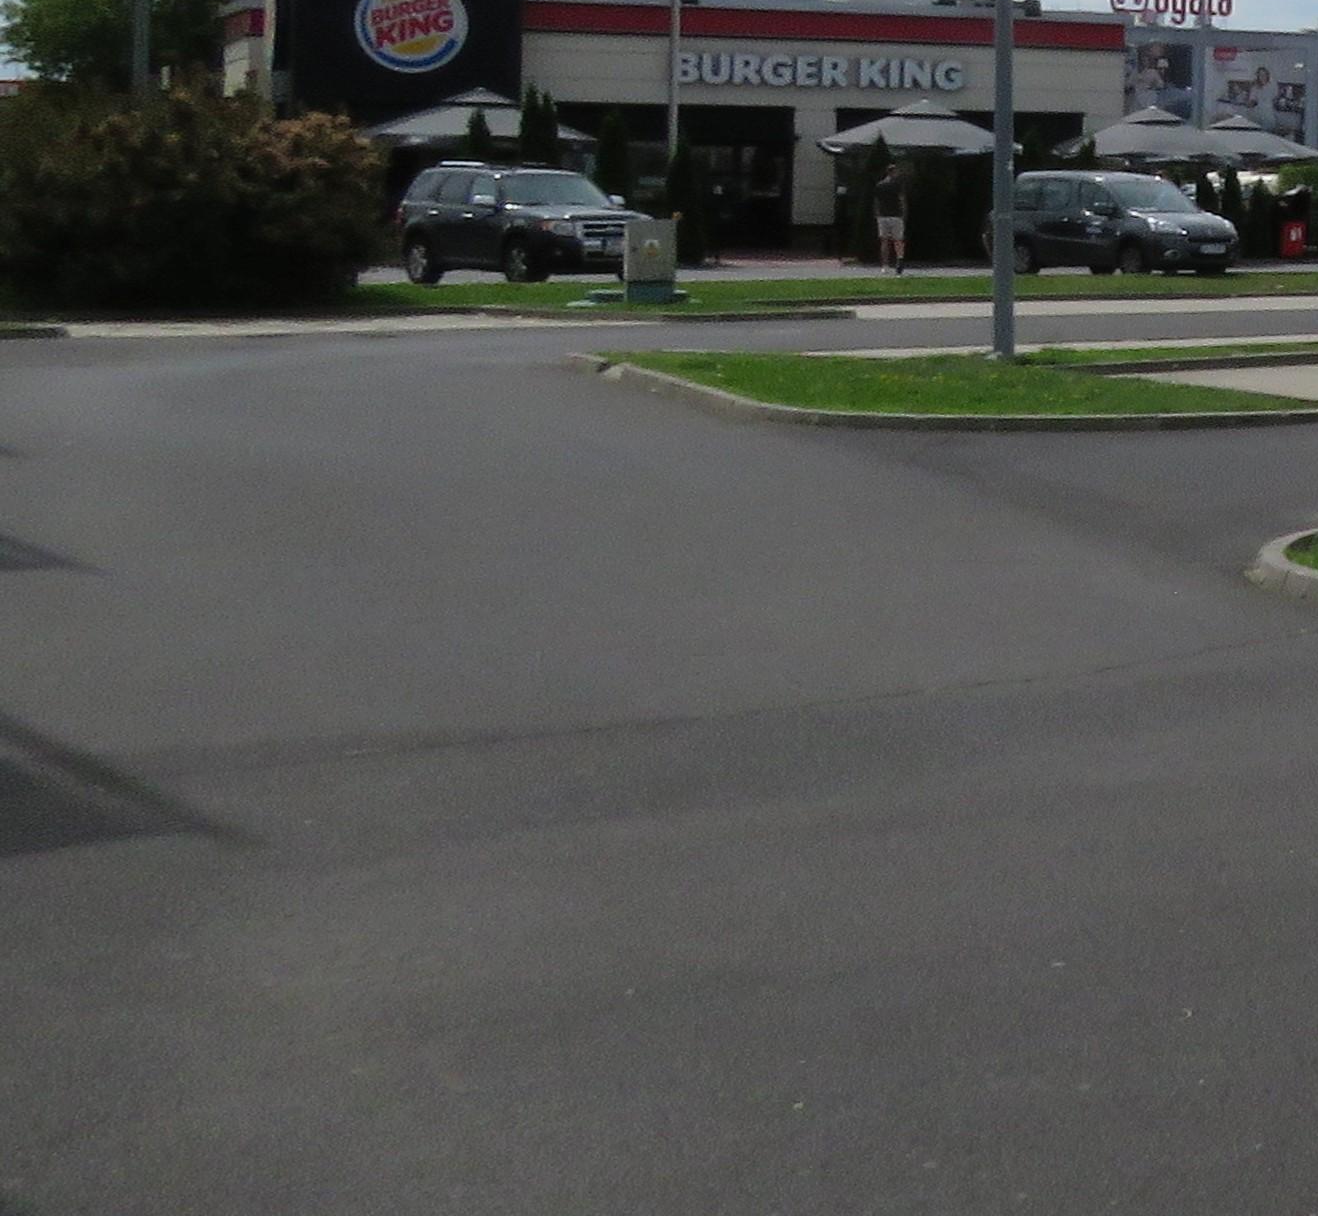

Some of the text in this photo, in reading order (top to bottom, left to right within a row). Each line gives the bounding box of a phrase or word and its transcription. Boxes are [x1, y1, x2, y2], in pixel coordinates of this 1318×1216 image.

[375, 10, 454, 49] KING
[676, 51, 966, 90] BURGER KING
